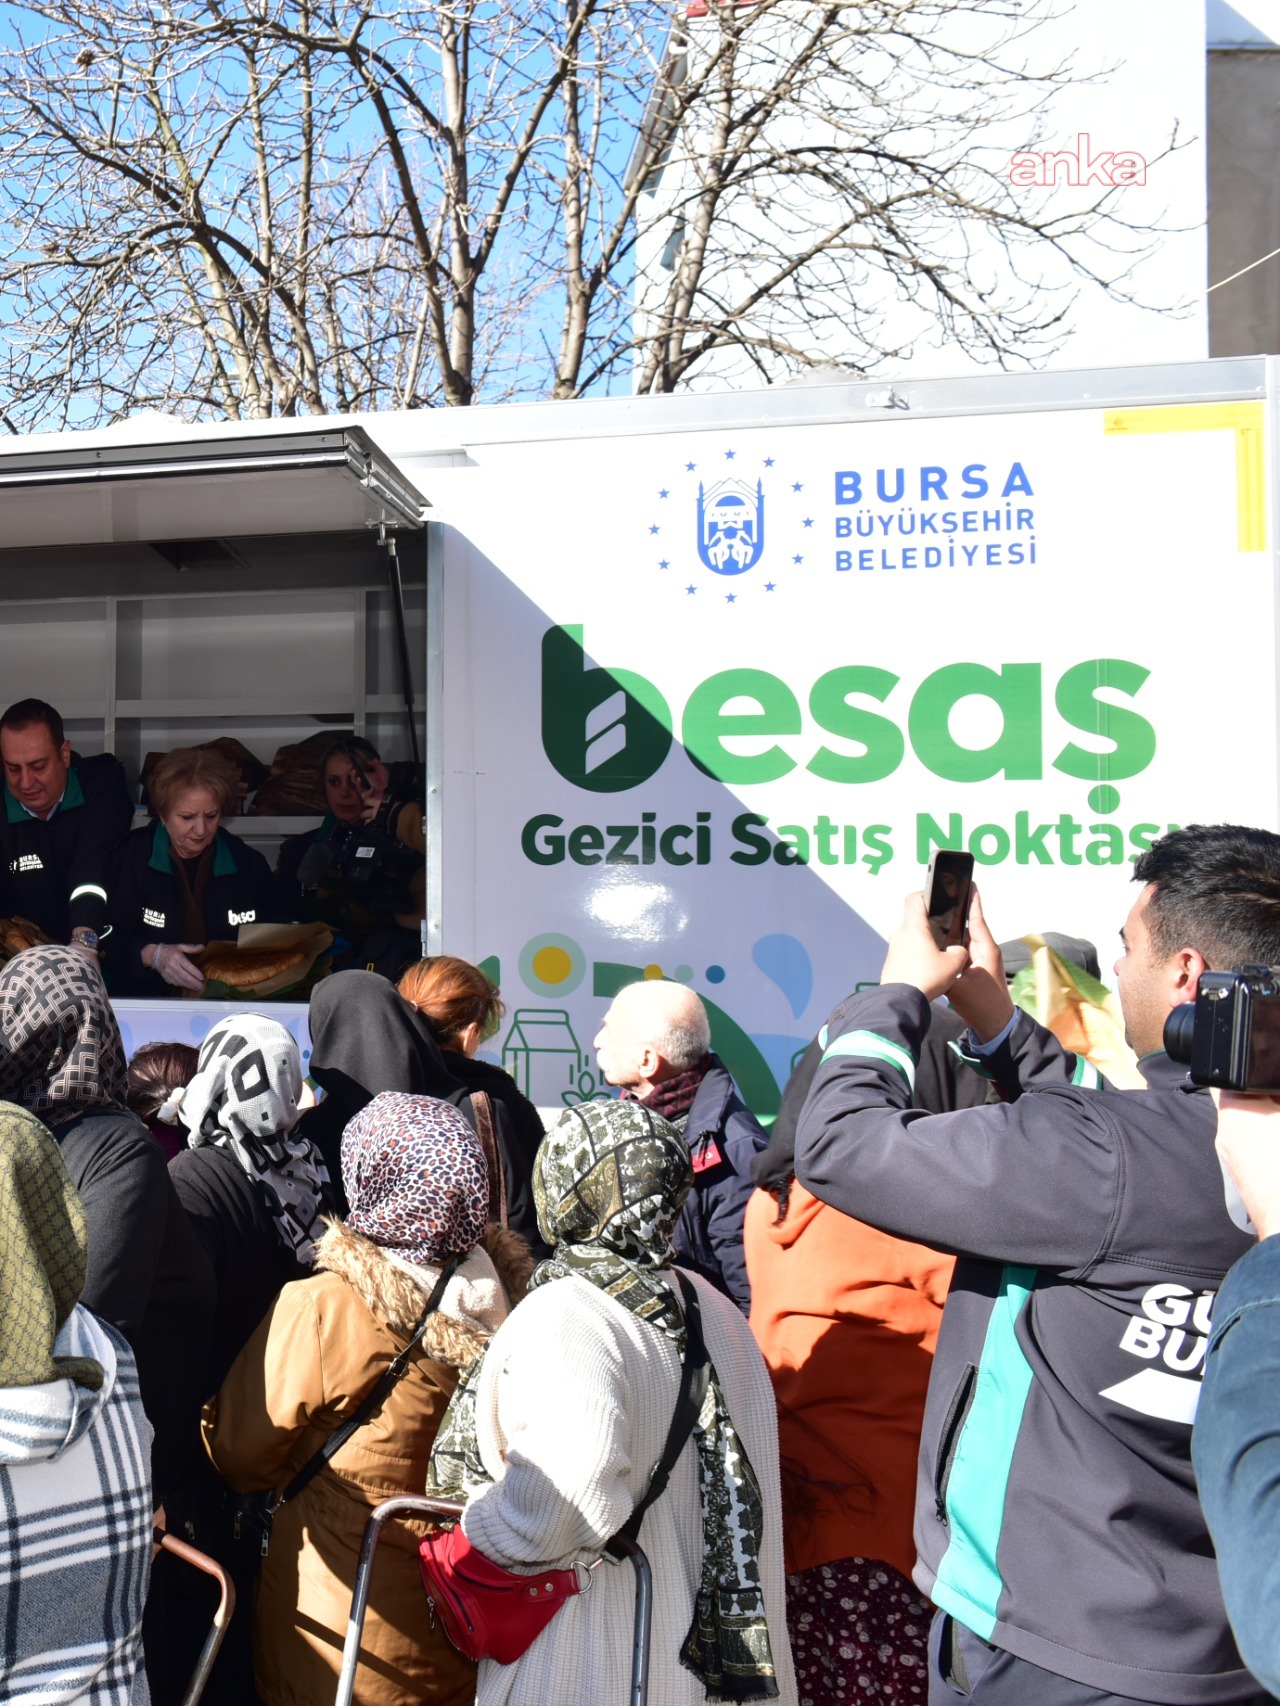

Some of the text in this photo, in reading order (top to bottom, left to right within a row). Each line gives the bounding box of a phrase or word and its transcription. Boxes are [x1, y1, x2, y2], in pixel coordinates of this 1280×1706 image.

[834, 462, 1035, 506] BURSA
[835, 501, 1035, 539] BÜYÜKŞEHİR
[835, 535, 1036, 572] BELEDİYESİ
[541, 623, 1157, 814] besaş
[521, 810, 1181, 876] Gezici Satış Noktas
[1119, 1315, 1209, 1376] BU
